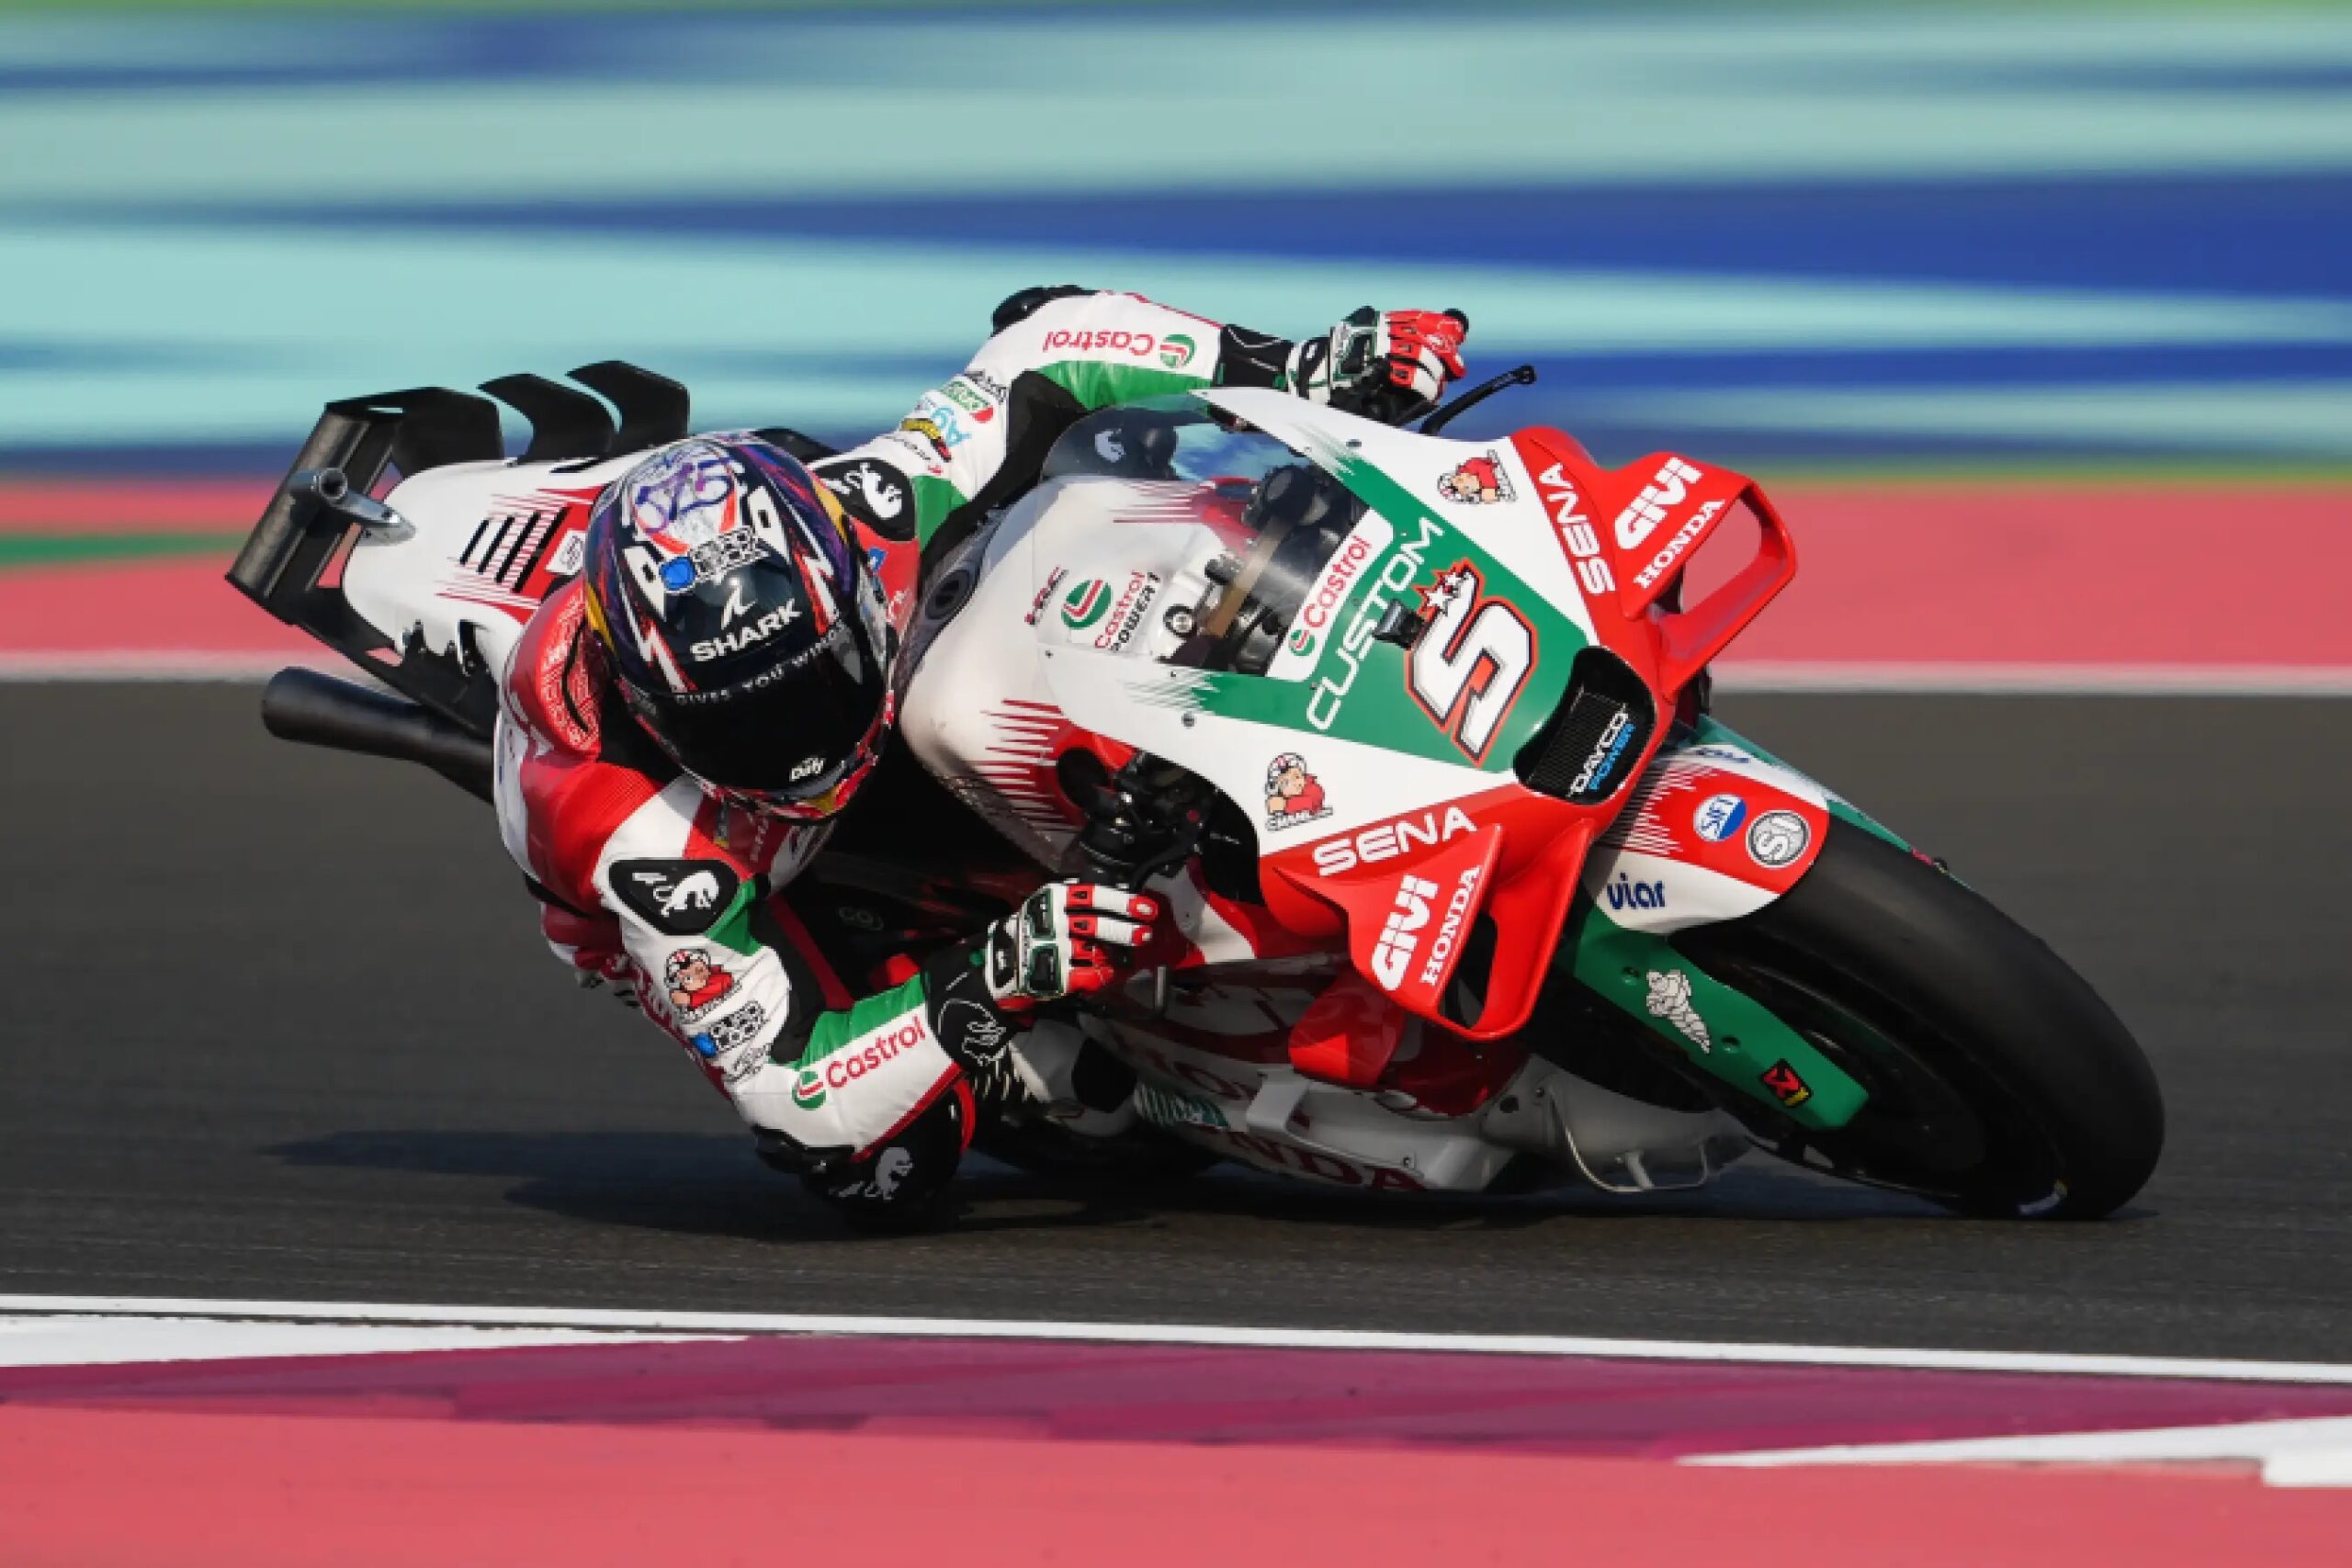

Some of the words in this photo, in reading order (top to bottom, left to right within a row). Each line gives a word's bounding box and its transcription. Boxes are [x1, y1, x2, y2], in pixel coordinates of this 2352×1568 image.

[1042, 330, 1155, 356] Castrol
[1539, 462, 1616, 594] SENA
[1614, 457, 1702, 550] GIVI
[1634, 499, 1725, 589] HONDA
[1303, 535, 1373, 628] Castrol
[1306, 516, 1444, 730] CUSTOM
[690, 598, 802, 662] SHARK
[1406, 558, 1537, 768] 5
[1313, 807, 1477, 876] SENA
[1371, 874, 1439, 991] GIVI
[1419, 865, 1482, 986] HONDA
[827, 1015, 925, 1088] Castrol
